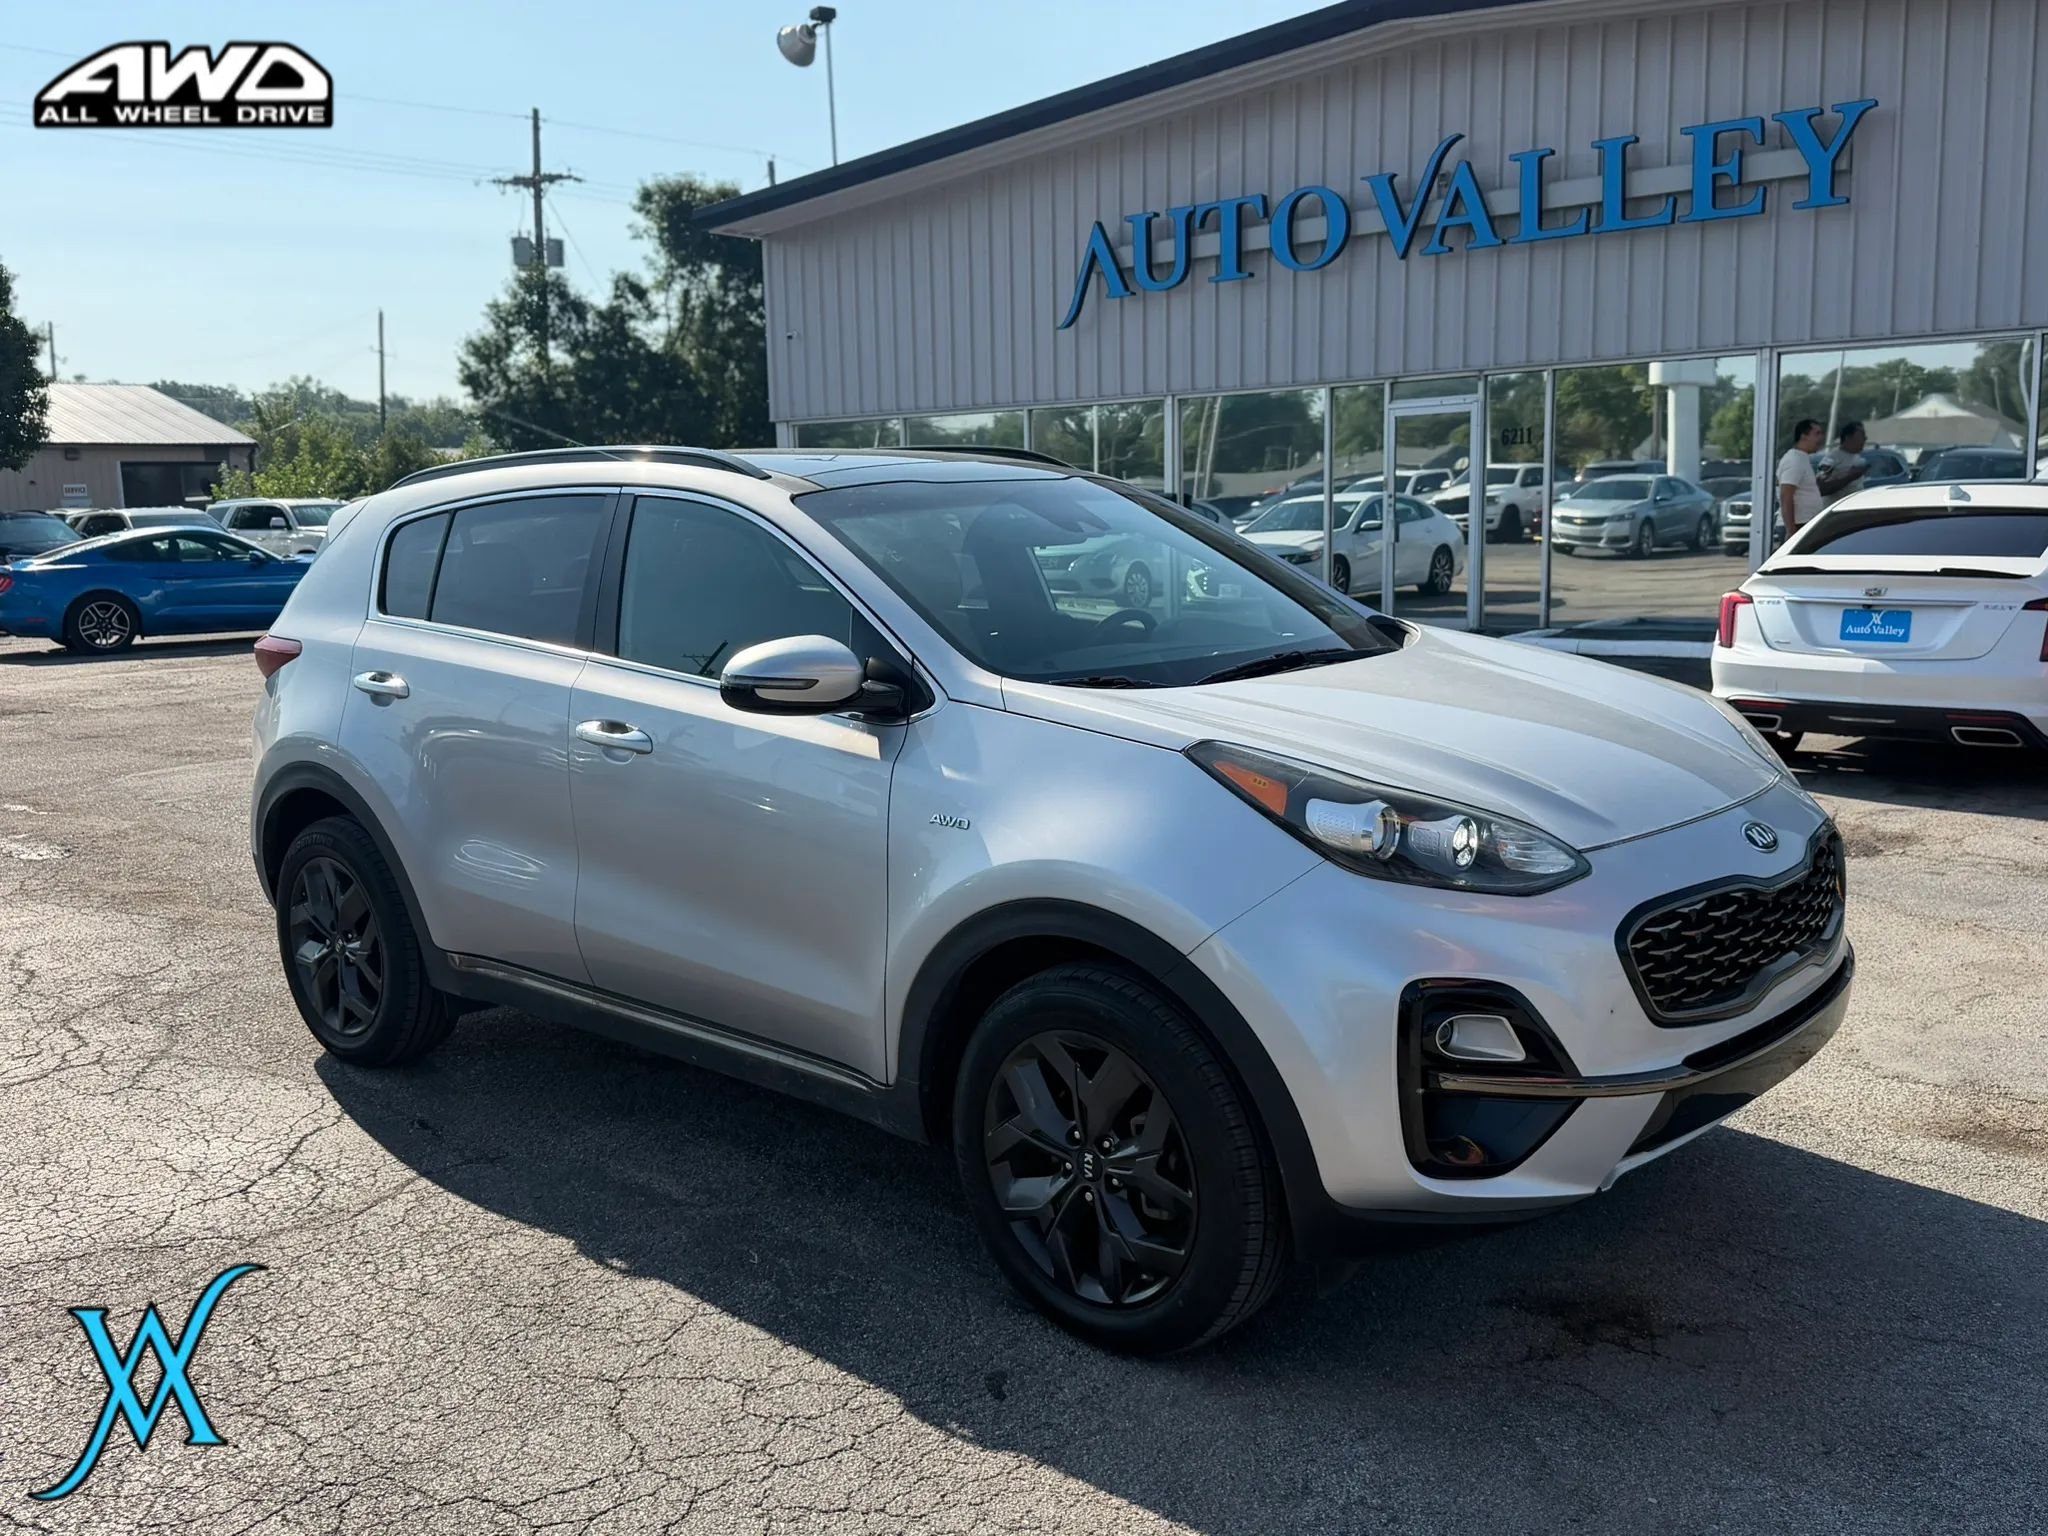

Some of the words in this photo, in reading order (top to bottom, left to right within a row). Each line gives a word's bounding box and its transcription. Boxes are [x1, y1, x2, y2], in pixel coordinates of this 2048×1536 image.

[1056, 185, 1351, 331] AUTO
[1361, 98, 1878, 260] VALLEY
[1502, 427, 1532, 445] 6211
[1845, 624, 1871, 634] Auto
[1872, 625, 1905, 637] Valley
[929, 814, 970, 830] AWD
[1083, 1152, 1094, 1178] KIA
